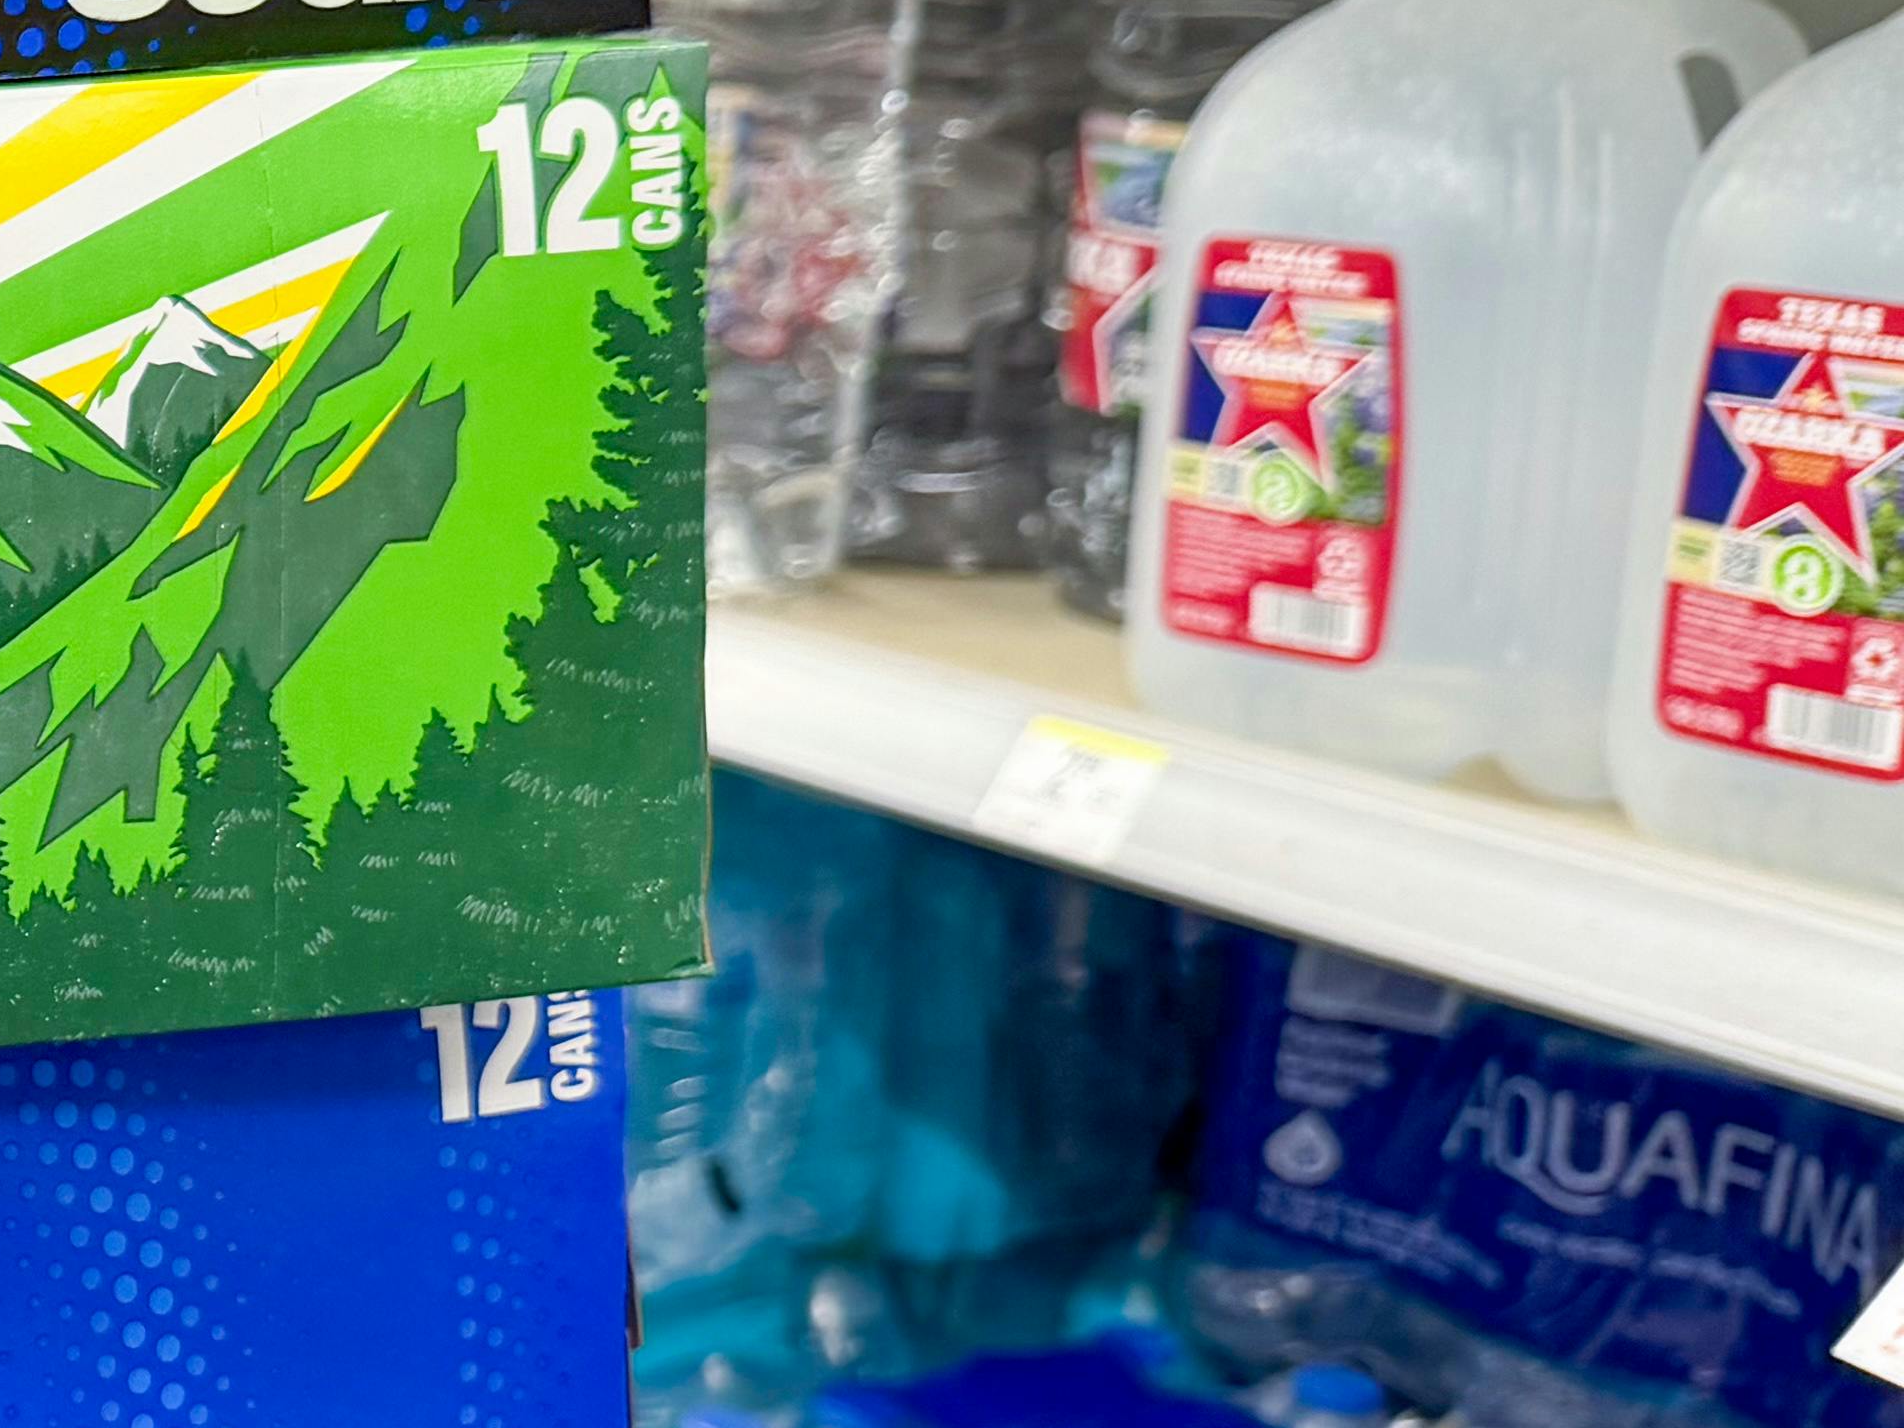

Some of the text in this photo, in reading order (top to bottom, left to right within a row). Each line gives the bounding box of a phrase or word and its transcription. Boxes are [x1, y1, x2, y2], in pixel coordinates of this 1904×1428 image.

[475, 96, 622, 258] 12
[627, 93, 685, 250] CANS
[420, 995, 544, 1123] 12
[1441, 1054, 1879, 1308] AQUAFINA
